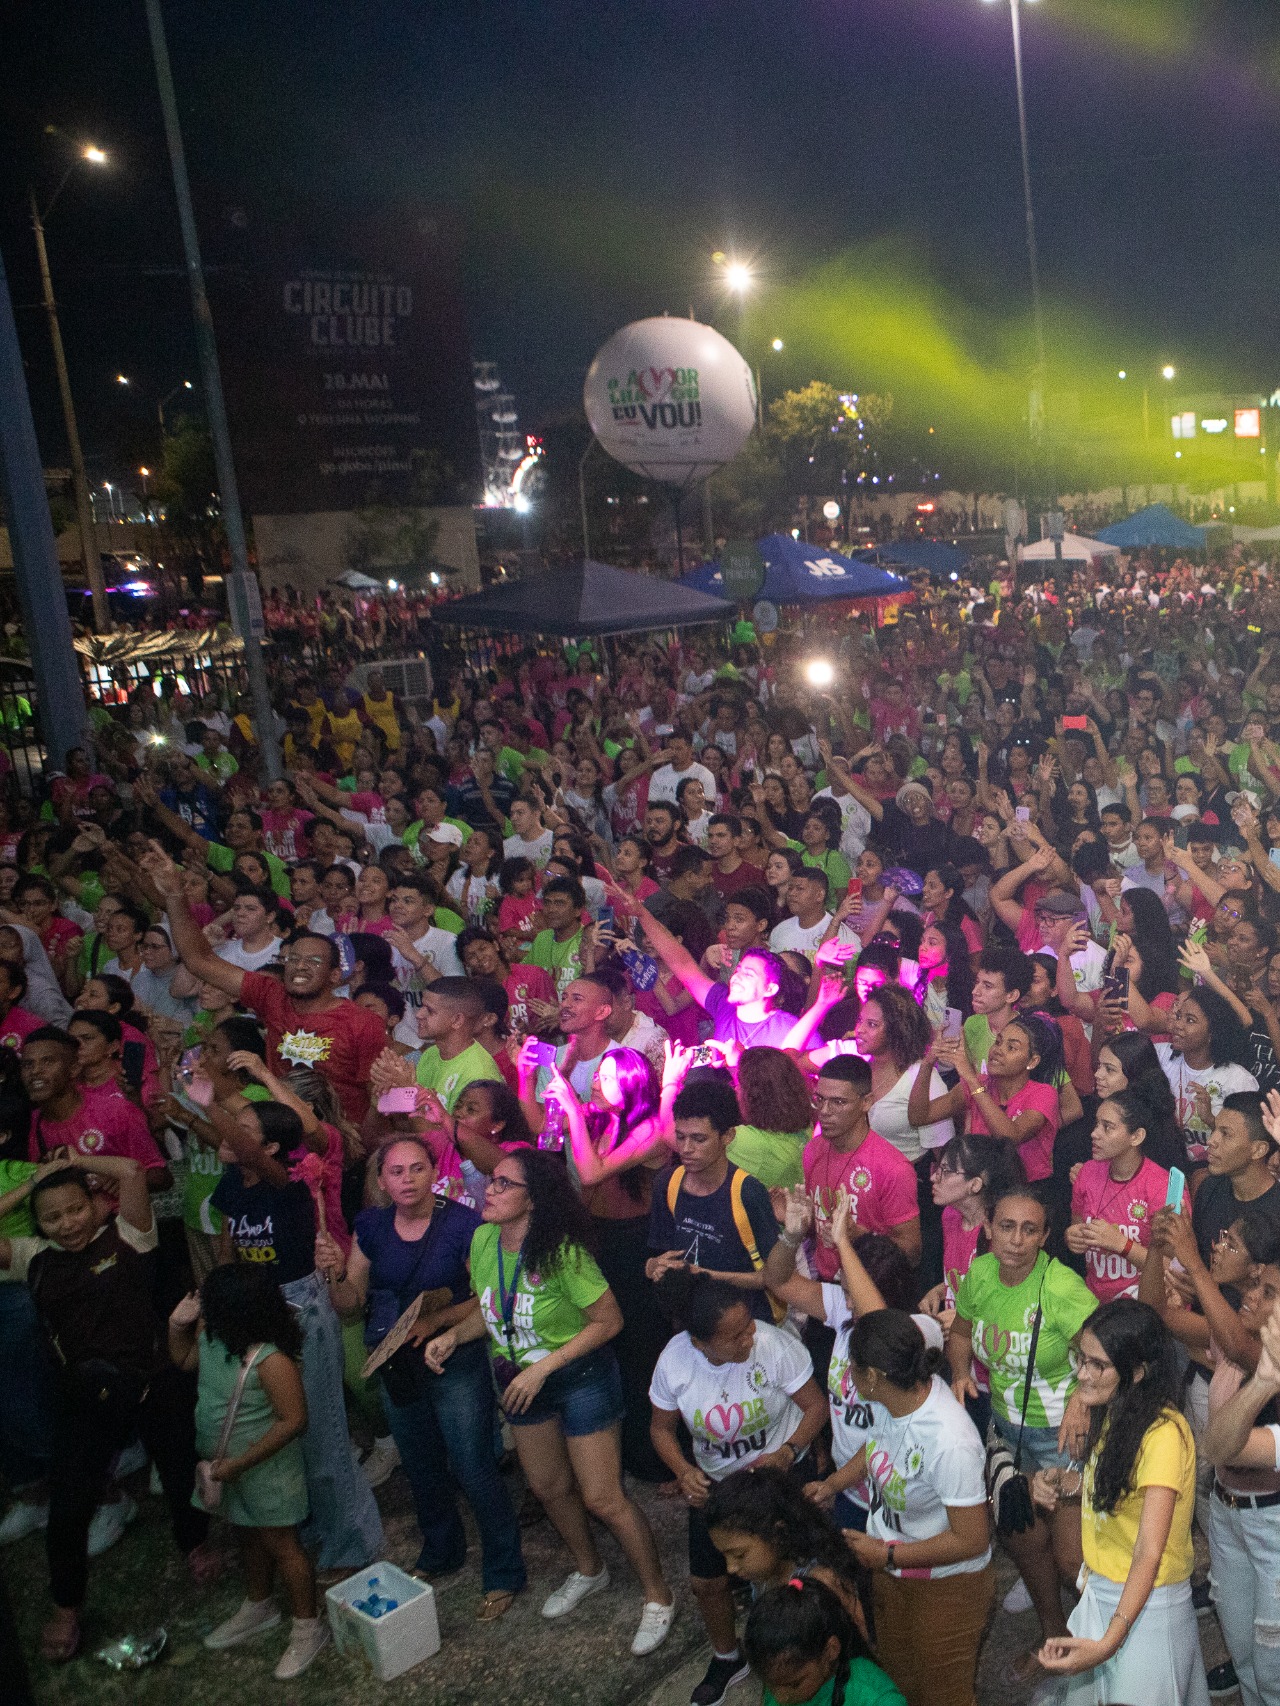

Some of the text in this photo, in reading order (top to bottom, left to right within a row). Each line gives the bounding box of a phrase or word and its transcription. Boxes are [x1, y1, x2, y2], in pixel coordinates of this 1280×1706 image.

[283, 281, 414, 316] CIRCUITO
[311, 315, 396, 346] CLUBE
[308, 413, 421, 425] TERESINA SHOPPING
[639, 401, 702, 429] VOU!
